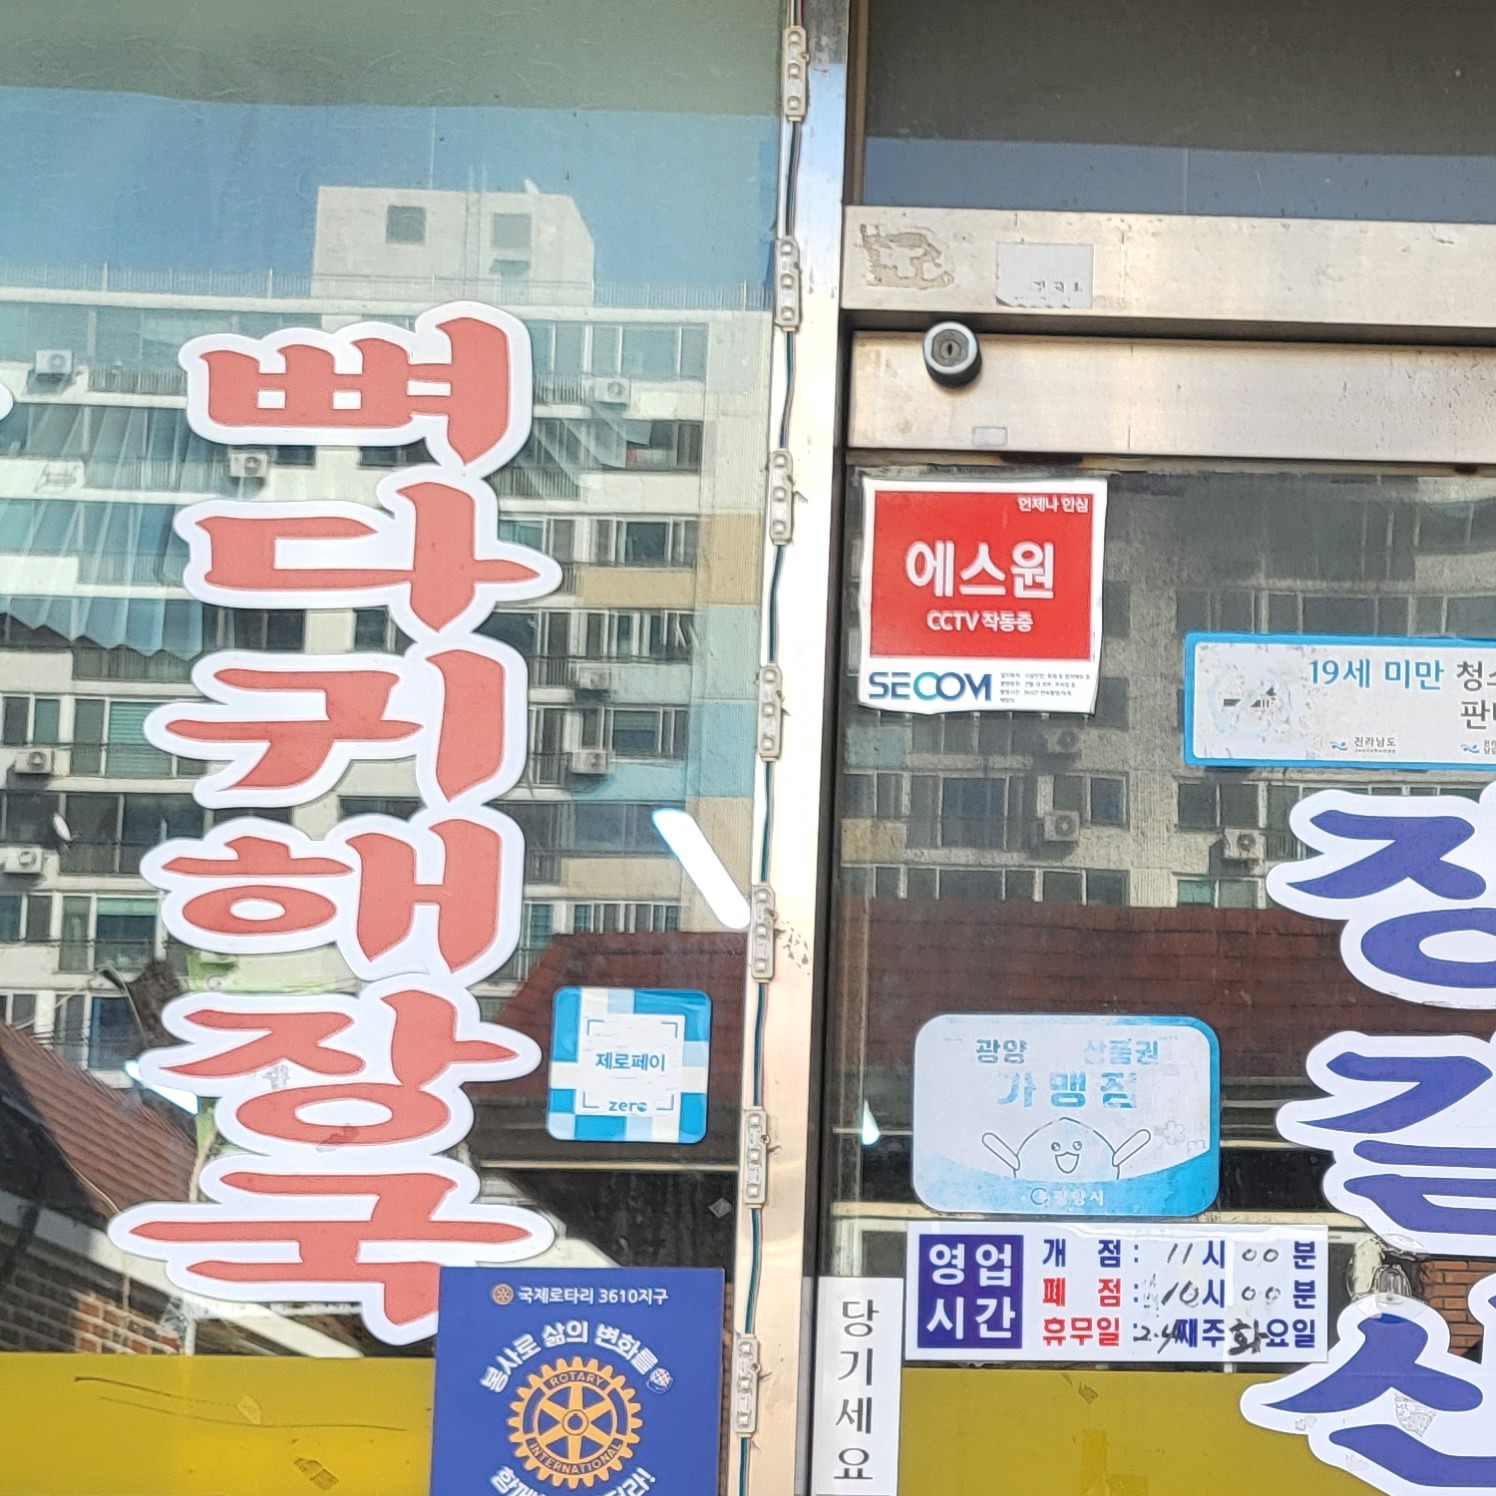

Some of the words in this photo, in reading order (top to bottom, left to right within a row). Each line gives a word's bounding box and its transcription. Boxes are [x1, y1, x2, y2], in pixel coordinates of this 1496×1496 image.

[1018, 496, 1059, 513] 언제나
[1061, 496, 1089, 514] 안심
[905, 540, 1055, 599] 에스원
[927, 610, 979, 632] CCTV
[981, 611, 1034, 633] 작동중
[868, 671, 993, 702] SECOM
[1308, 658, 1372, 690] 19세
[1384, 658, 1445, 692] 미만
[595, 1052, 667, 1073] 제로페이
[975, 1038, 1028, 1065] 광양
[517, 1286, 595, 1305] 국제로타리
[599, 1287, 669, 1306] 3610지구
[480, 1332, 542, 1393] 봉사로
[541, 1319, 589, 1348] 삶의
[594, 1321, 660, 1376] 변화를
[548, 1371, 606, 1388] ROTARY
[833, 1298, 880, 1481] 당기세요
[529, 1441, 624, 1476] INTERNATIONAL
